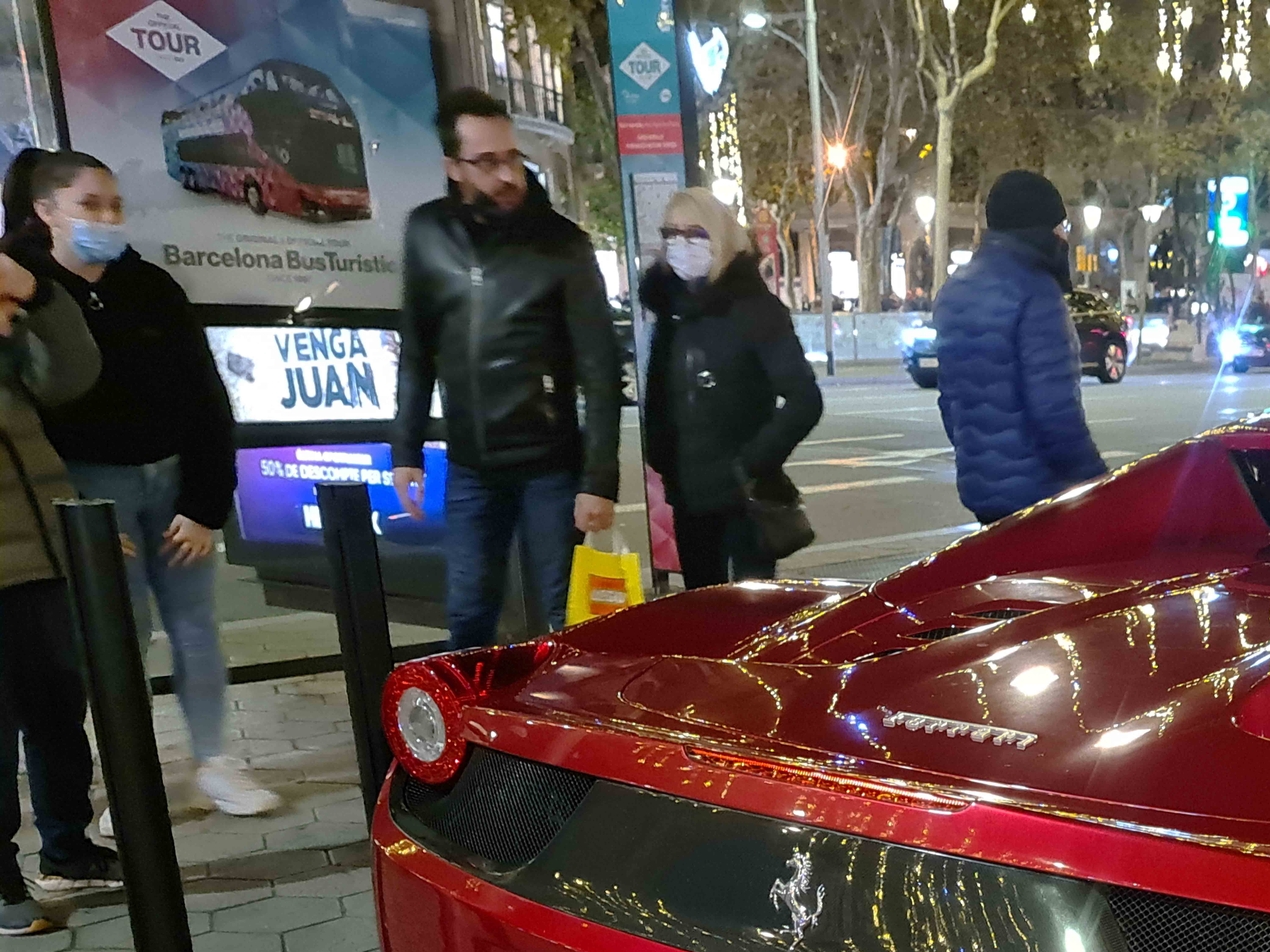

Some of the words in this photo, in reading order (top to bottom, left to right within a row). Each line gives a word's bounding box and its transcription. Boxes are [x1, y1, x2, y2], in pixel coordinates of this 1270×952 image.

[130, 27, 201, 56] TOUR
[628, 60, 661, 74] TOUR
[162, 243, 283, 269] Barcelona
[274, 330, 367, 362] VENGA
[281, 362, 380, 409] JUAN
[260, 459, 284, 477] 50%
[285, 463, 299, 478] DE
[361, 468, 381, 484] PER
